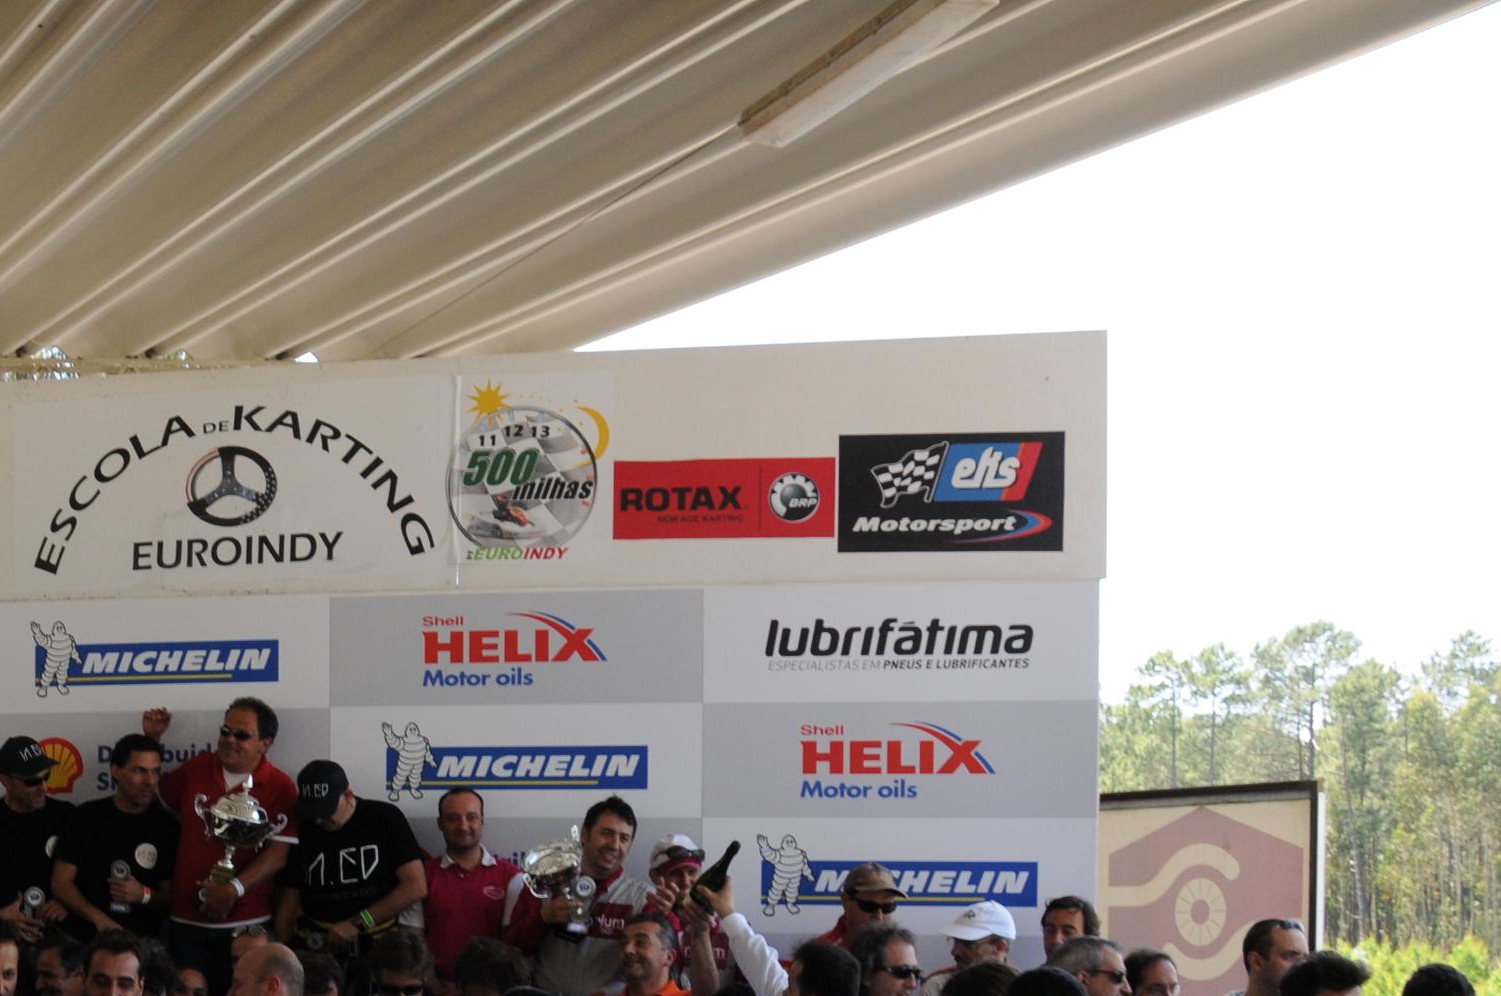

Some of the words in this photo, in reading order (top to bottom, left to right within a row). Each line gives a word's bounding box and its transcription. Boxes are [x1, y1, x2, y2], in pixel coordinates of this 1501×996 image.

[463, 448, 540, 486] 500
[34, 415, 196, 574] ESCOLA
[202, 420, 229, 434] DE
[233, 405, 436, 556] KARTING
[512, 477, 594, 502] milhas
[620, 486, 743, 512] ROTAX
[790, 498, 818, 508] BRP
[657, 515, 678, 523] NEW
[703, 514, 744, 523] KARTING
[853, 515, 1018, 536] Motorsport
[132, 530, 343, 571] EUROINDY
[473, 545, 569, 561] EUROINDY
[422, 616, 464, 627] Shell
[422, 628, 607, 663] HELIX
[81, 647, 272, 675] MICHELIN
[768, 660, 859, 672] ESPECIALISTAS
[862, 660, 881, 670] EM
[883, 659, 922, 670] PNEUS
[926, 659, 932, 669] E
[936, 658, 1030, 670] LUBRIFICANTES
[422, 669, 491, 686] Motor
[495, 668, 534, 686] oils
[800, 724, 844, 736] Shell
[437, 753, 640, 778] MICHELIN
[800, 739, 995, 774] HELIX
[800, 780, 873, 798] Motor
[878, 780, 918, 798] oils
[815, 869, 1029, 894] MHELIN
